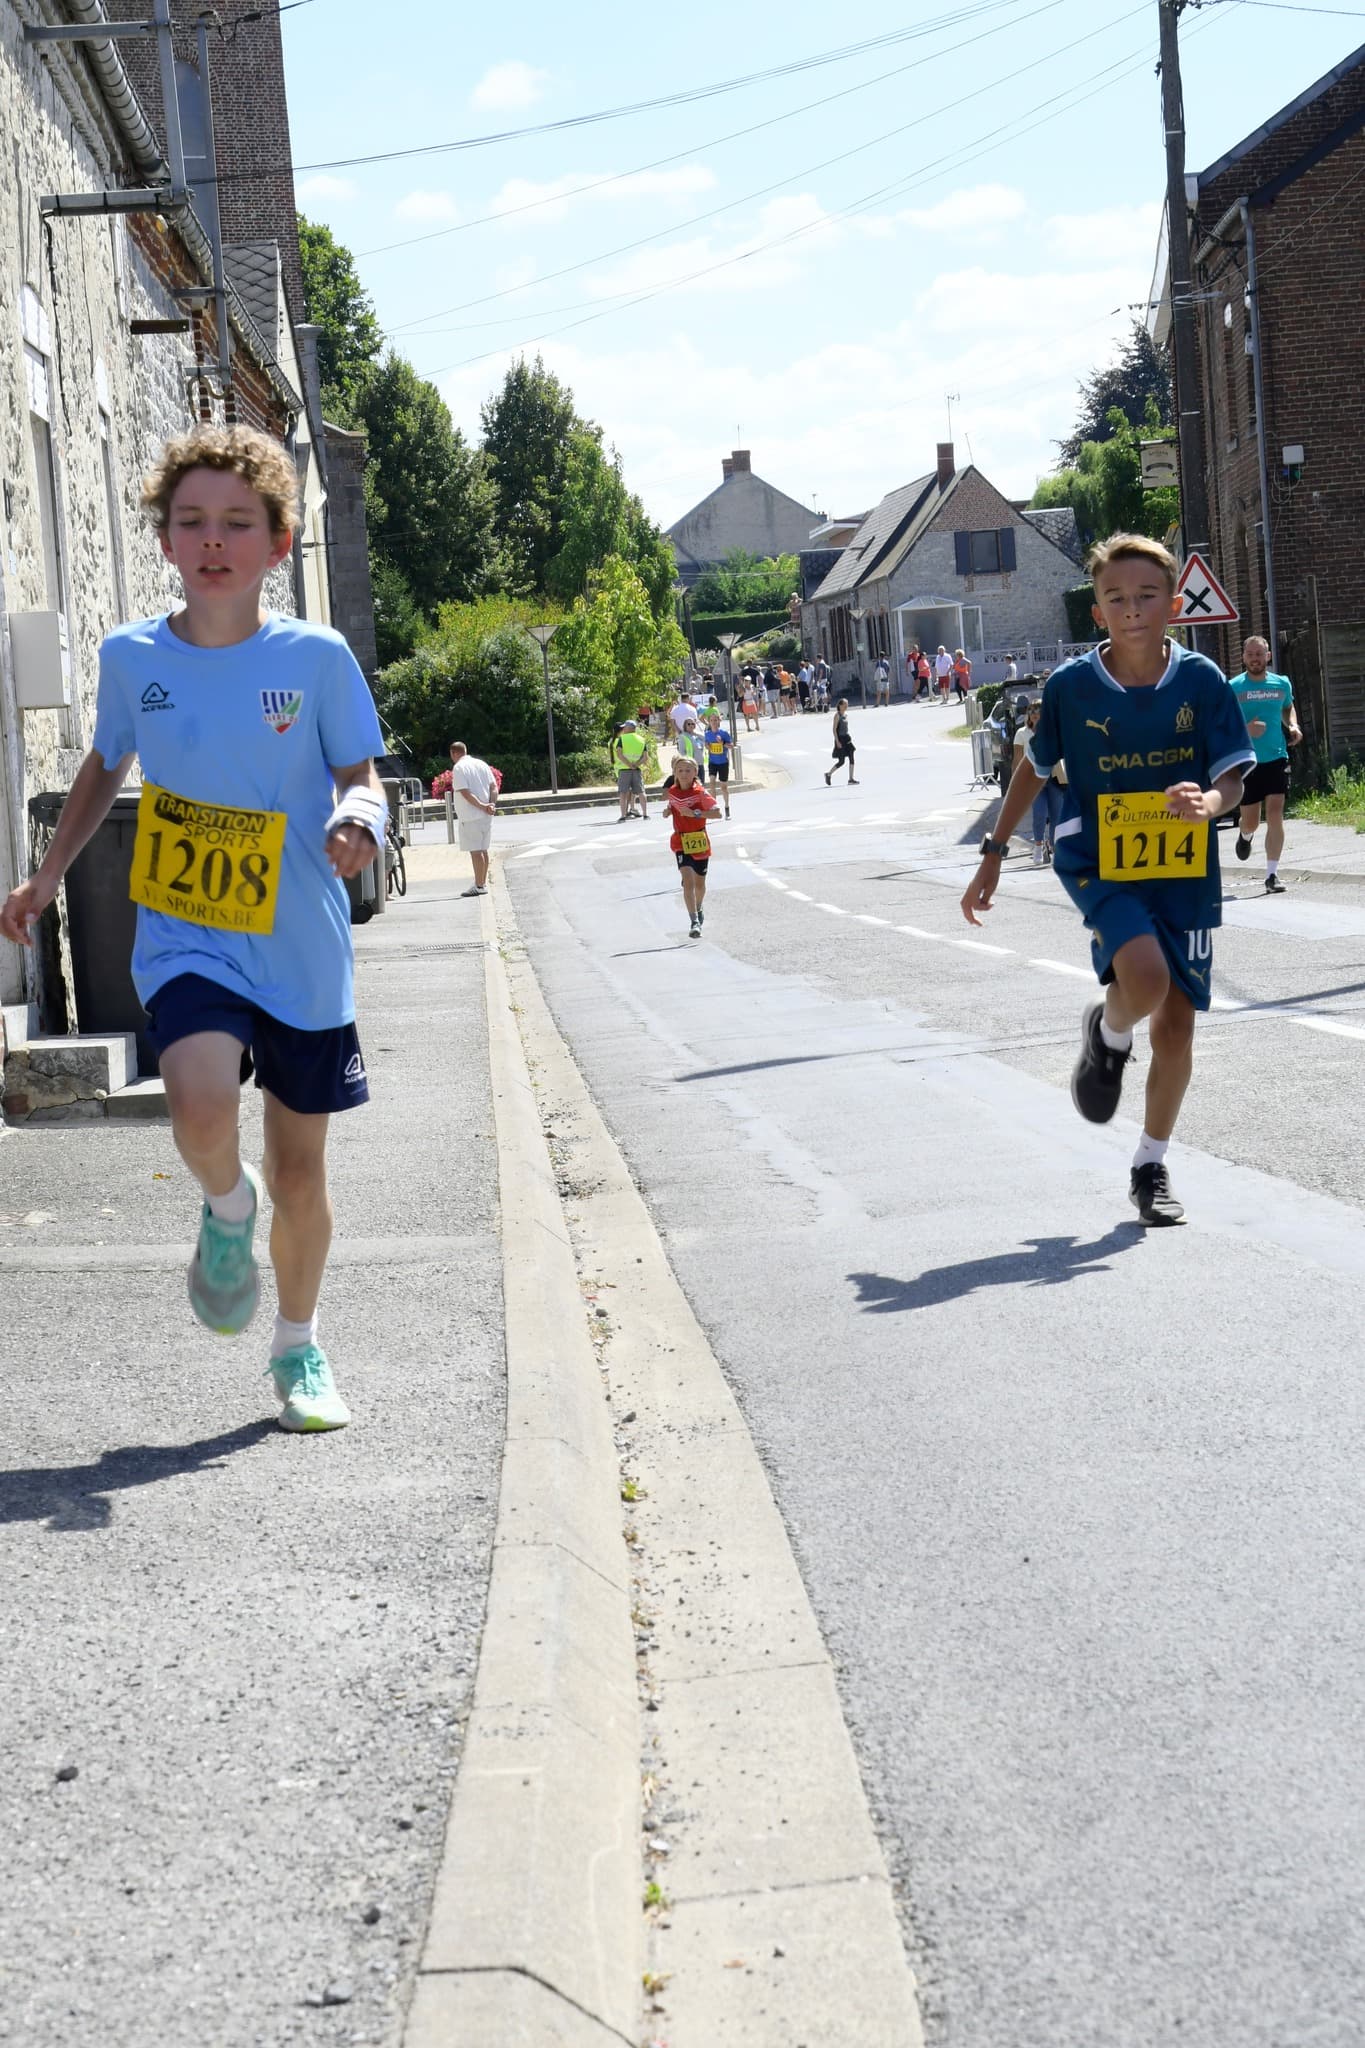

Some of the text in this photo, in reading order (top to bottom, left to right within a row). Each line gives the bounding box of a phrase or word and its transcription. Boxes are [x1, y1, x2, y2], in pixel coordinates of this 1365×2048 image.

[1099, 747, 1194, 772] CMA CGM
[158, 796, 265, 833] TRANSITION
[1123, 810, 1185, 822] ULTRATIM
[184, 822, 262, 850] SPORTS
[1112, 831, 1195, 869] 1214
[144, 831, 269, 908] 1208
[1184, 928, 1210, 960] 10
